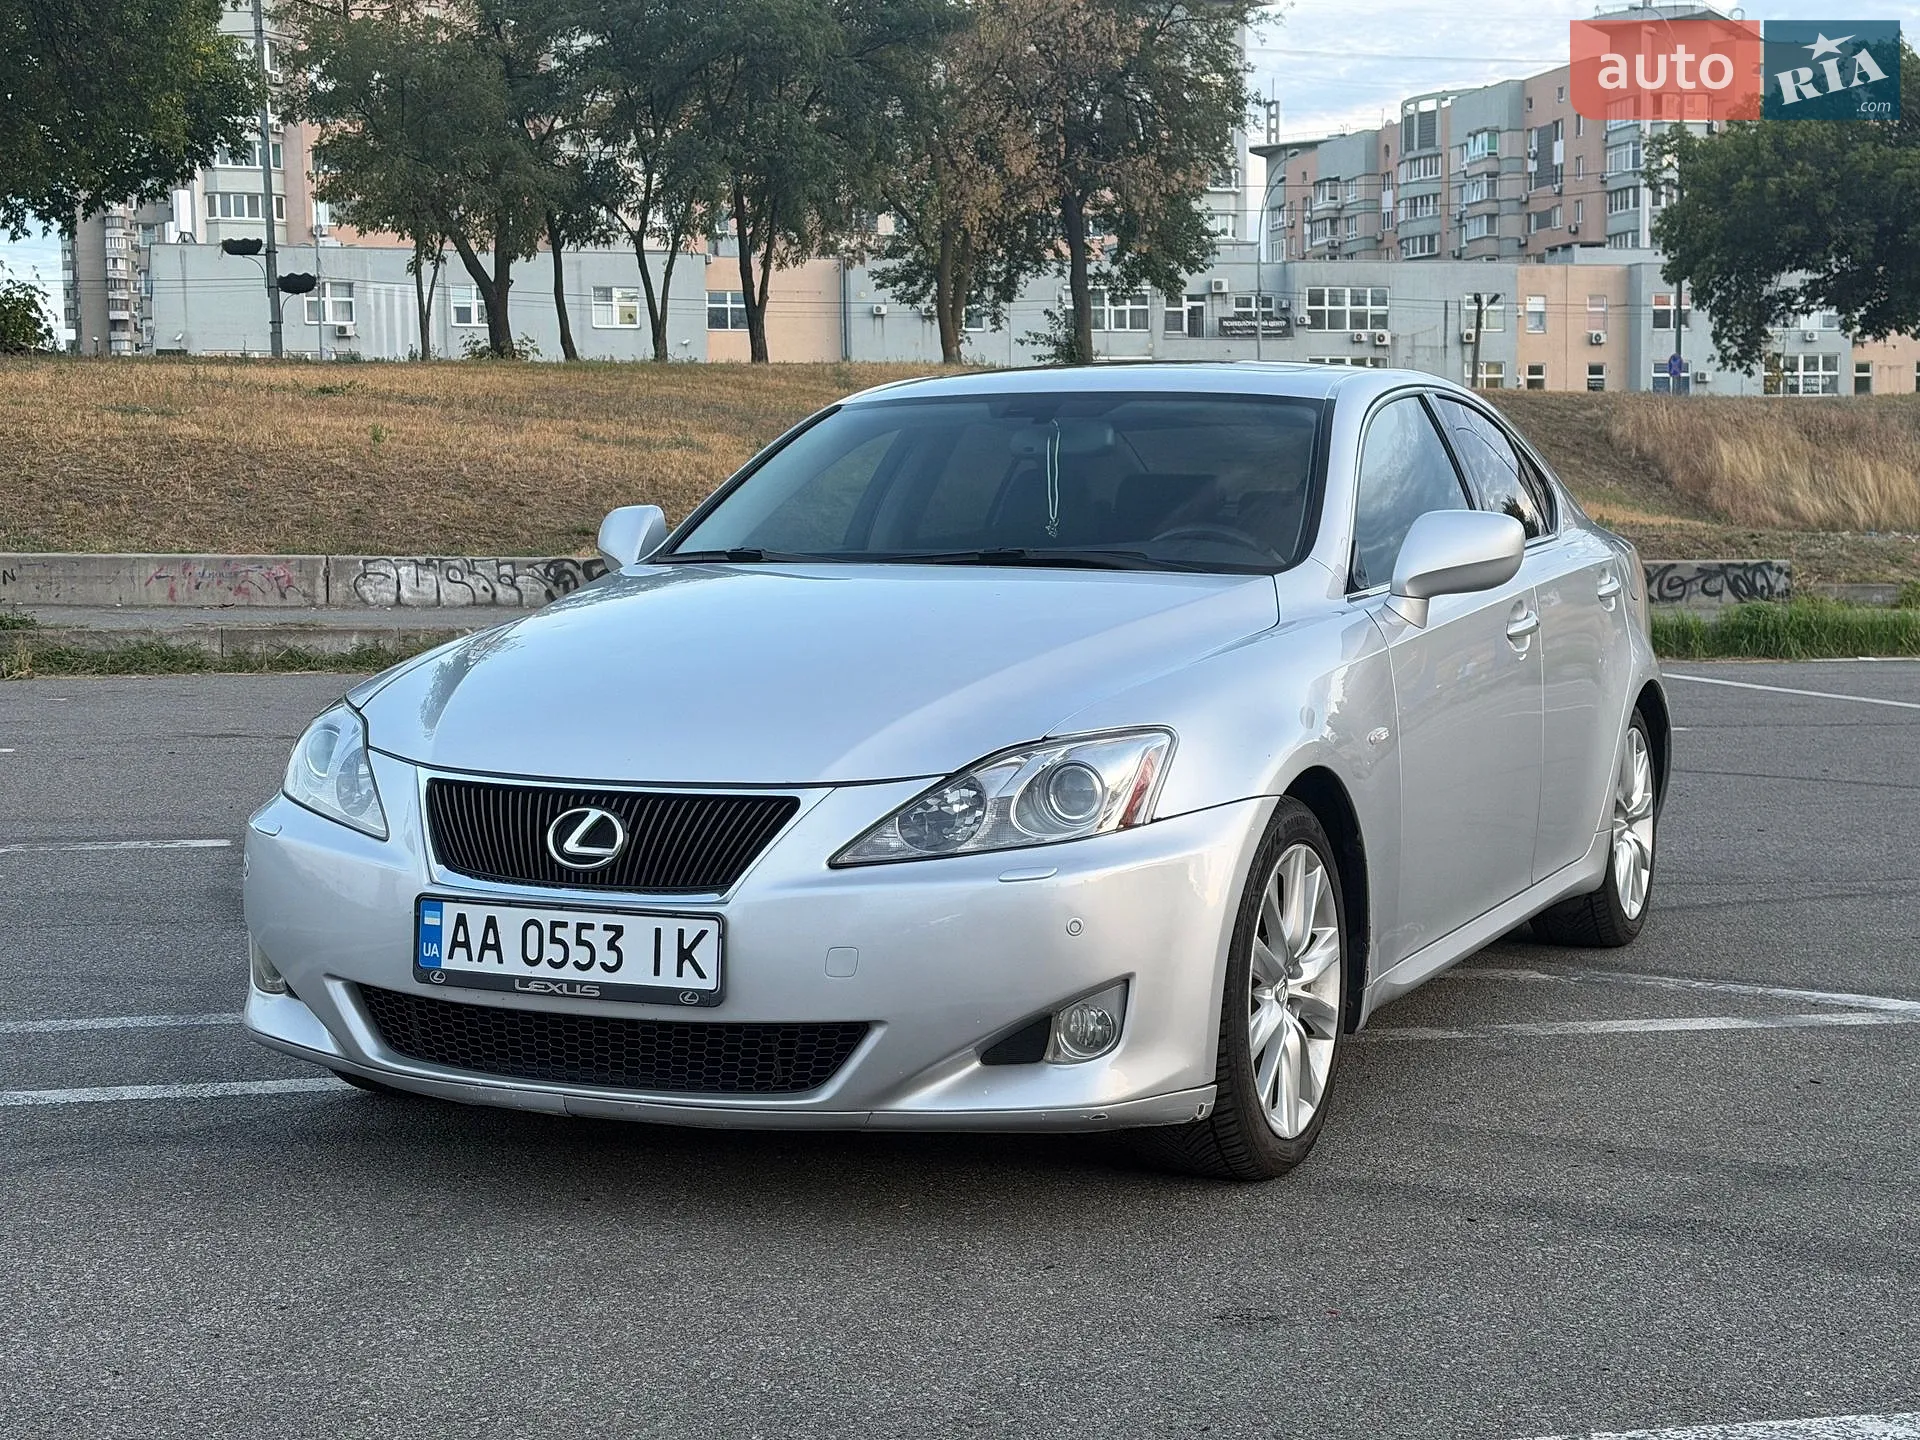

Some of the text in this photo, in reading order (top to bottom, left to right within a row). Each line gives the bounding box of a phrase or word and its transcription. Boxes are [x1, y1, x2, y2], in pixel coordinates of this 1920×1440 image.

[423, 942, 439, 958] UA
[447, 913, 709, 980] AA 0553 IK
[514, 978, 601, 997] LEXUS
